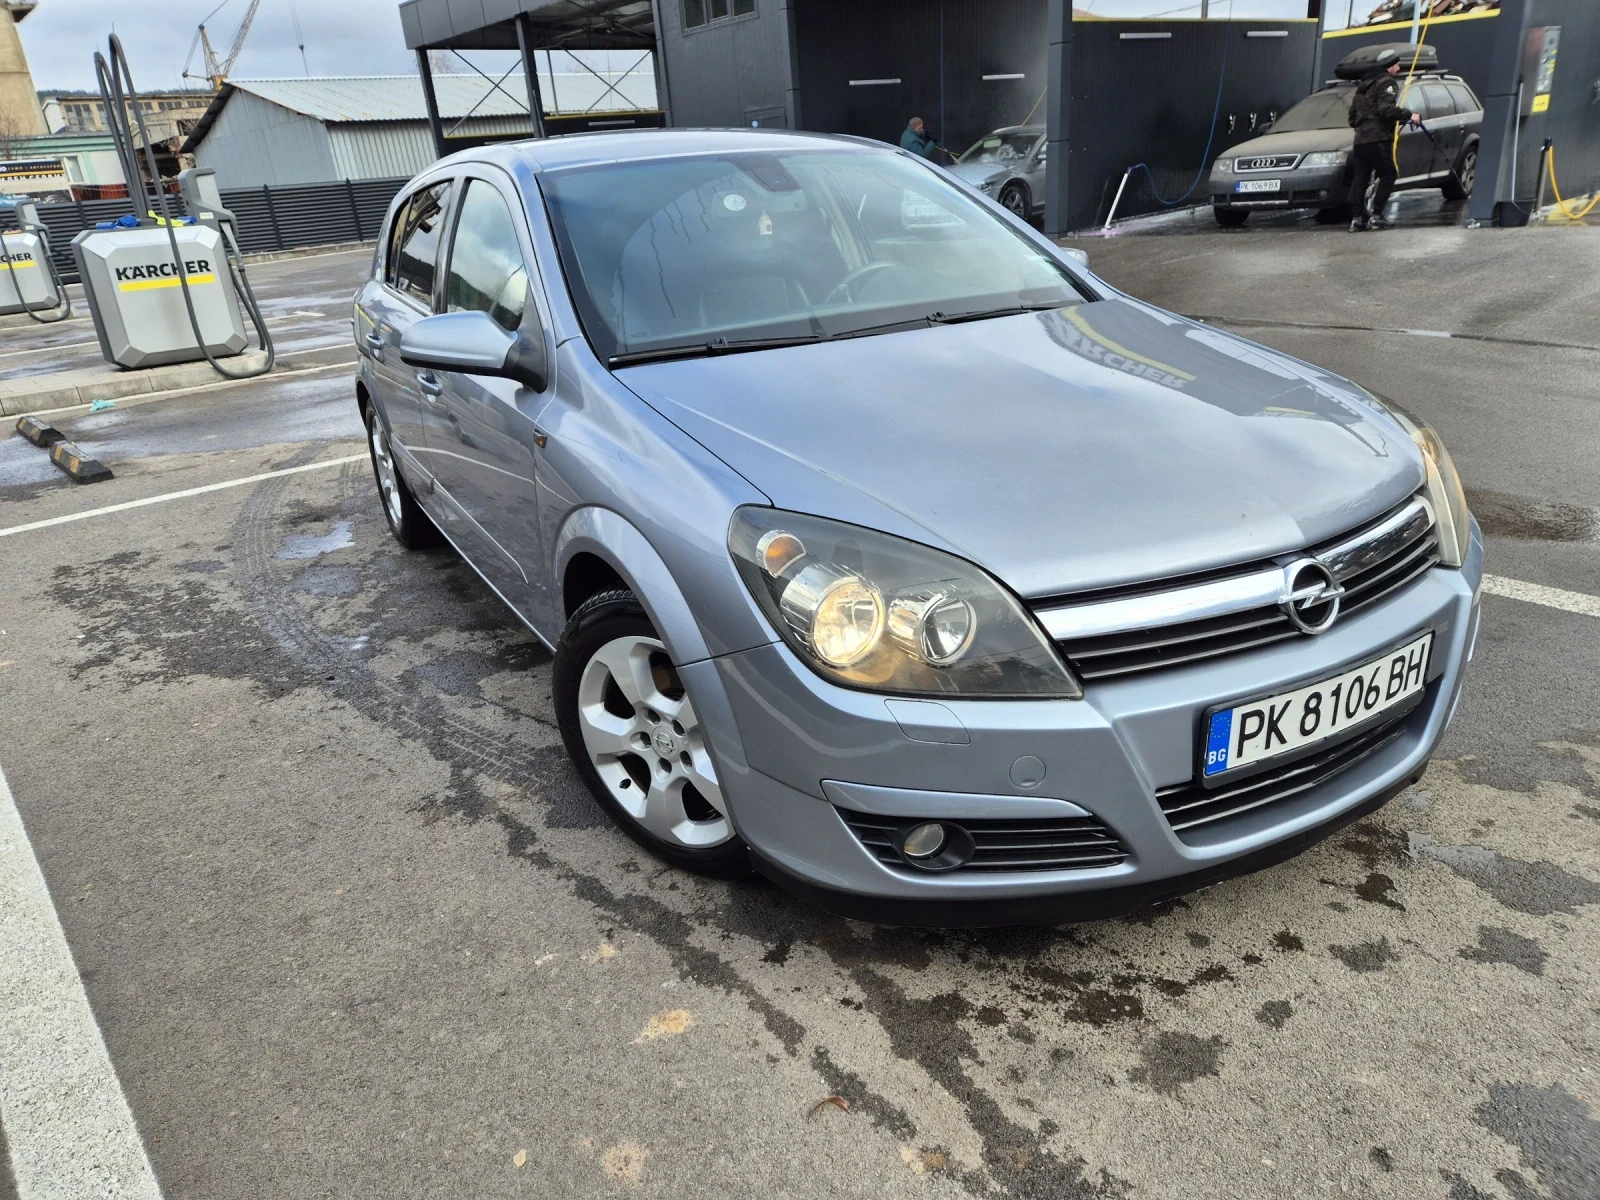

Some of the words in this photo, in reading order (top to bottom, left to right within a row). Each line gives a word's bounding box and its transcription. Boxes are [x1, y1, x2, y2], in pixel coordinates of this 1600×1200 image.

[1251, 181, 1267, 189] 1069
[1268, 180, 1279, 188] BX
[0, 252, 32, 263] CHER
[115, 260, 212, 281] KÄRCHER
[1236, 699, 1292, 759] PK
[1299, 666, 1382, 737] 8106
[1385, 643, 1426, 703] BH
[1207, 748, 1227, 766] BG
